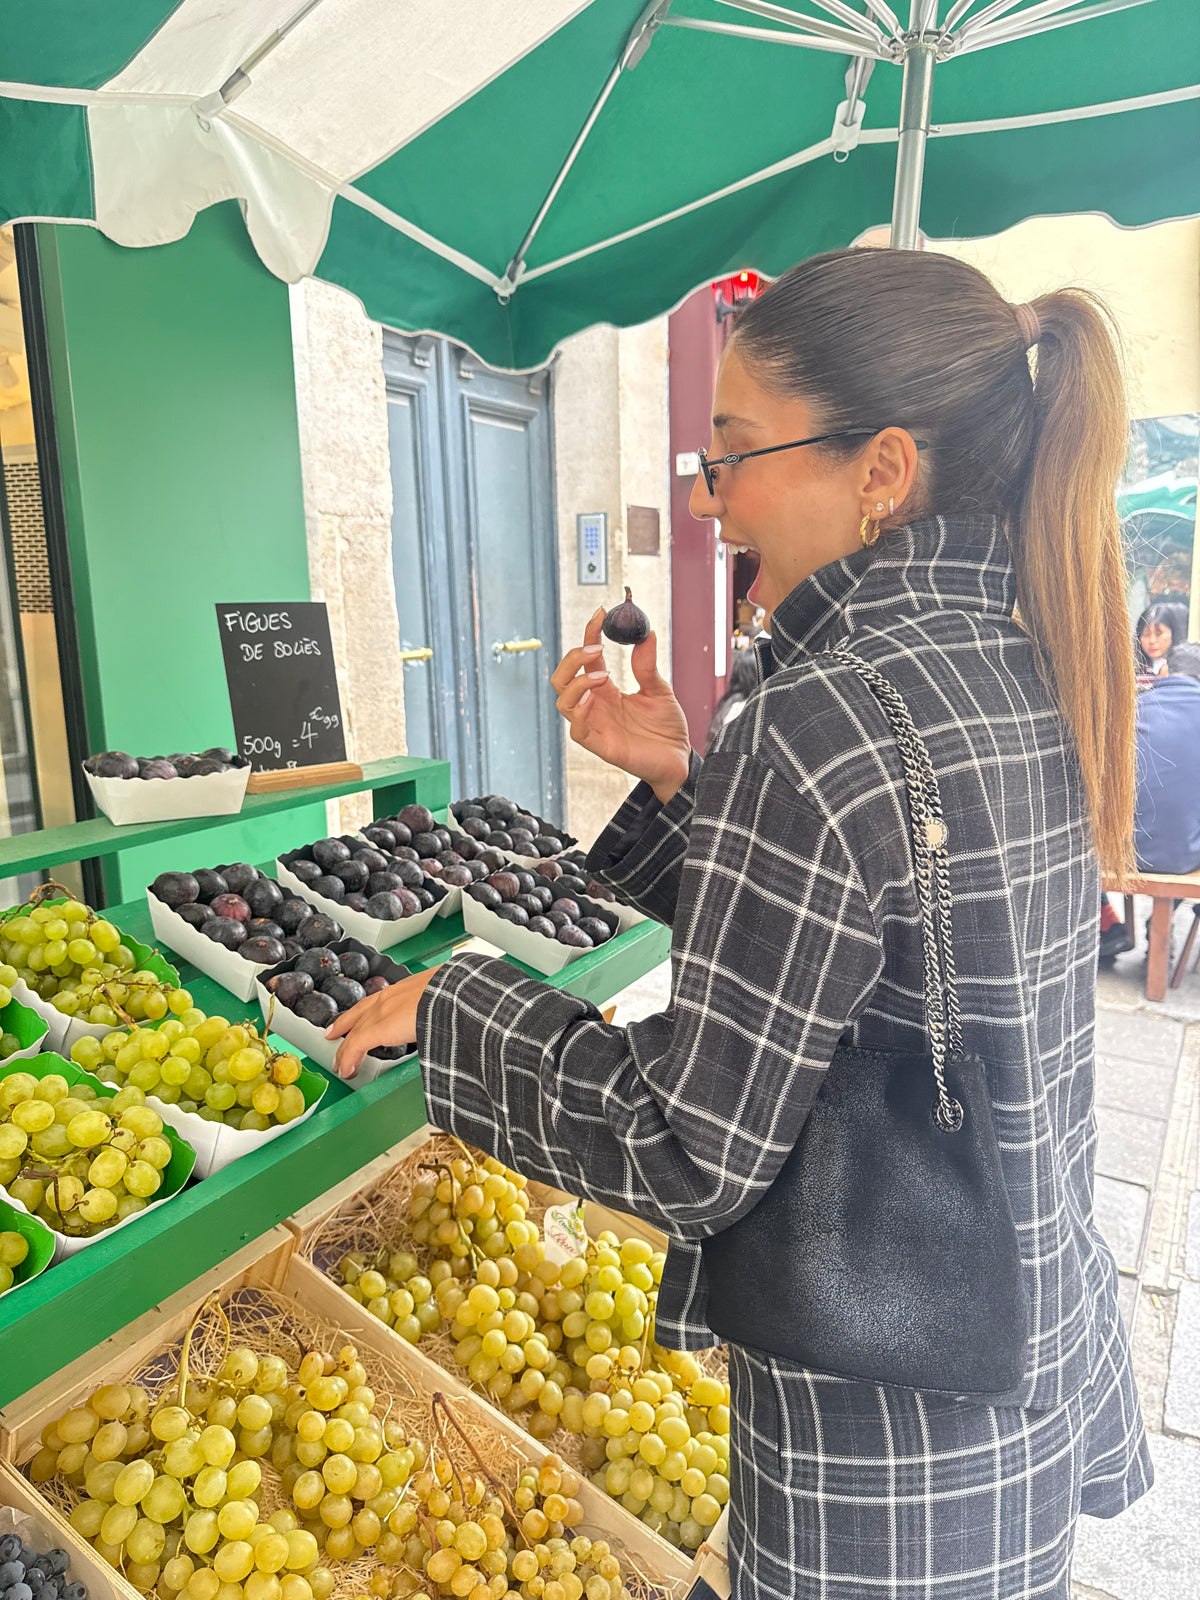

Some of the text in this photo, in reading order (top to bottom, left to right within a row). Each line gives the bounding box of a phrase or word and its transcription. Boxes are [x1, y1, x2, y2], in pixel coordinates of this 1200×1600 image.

[224, 611, 292, 633] FIGUES
[240, 643, 264, 662] DE
[243, 735, 281, 758] 500g
